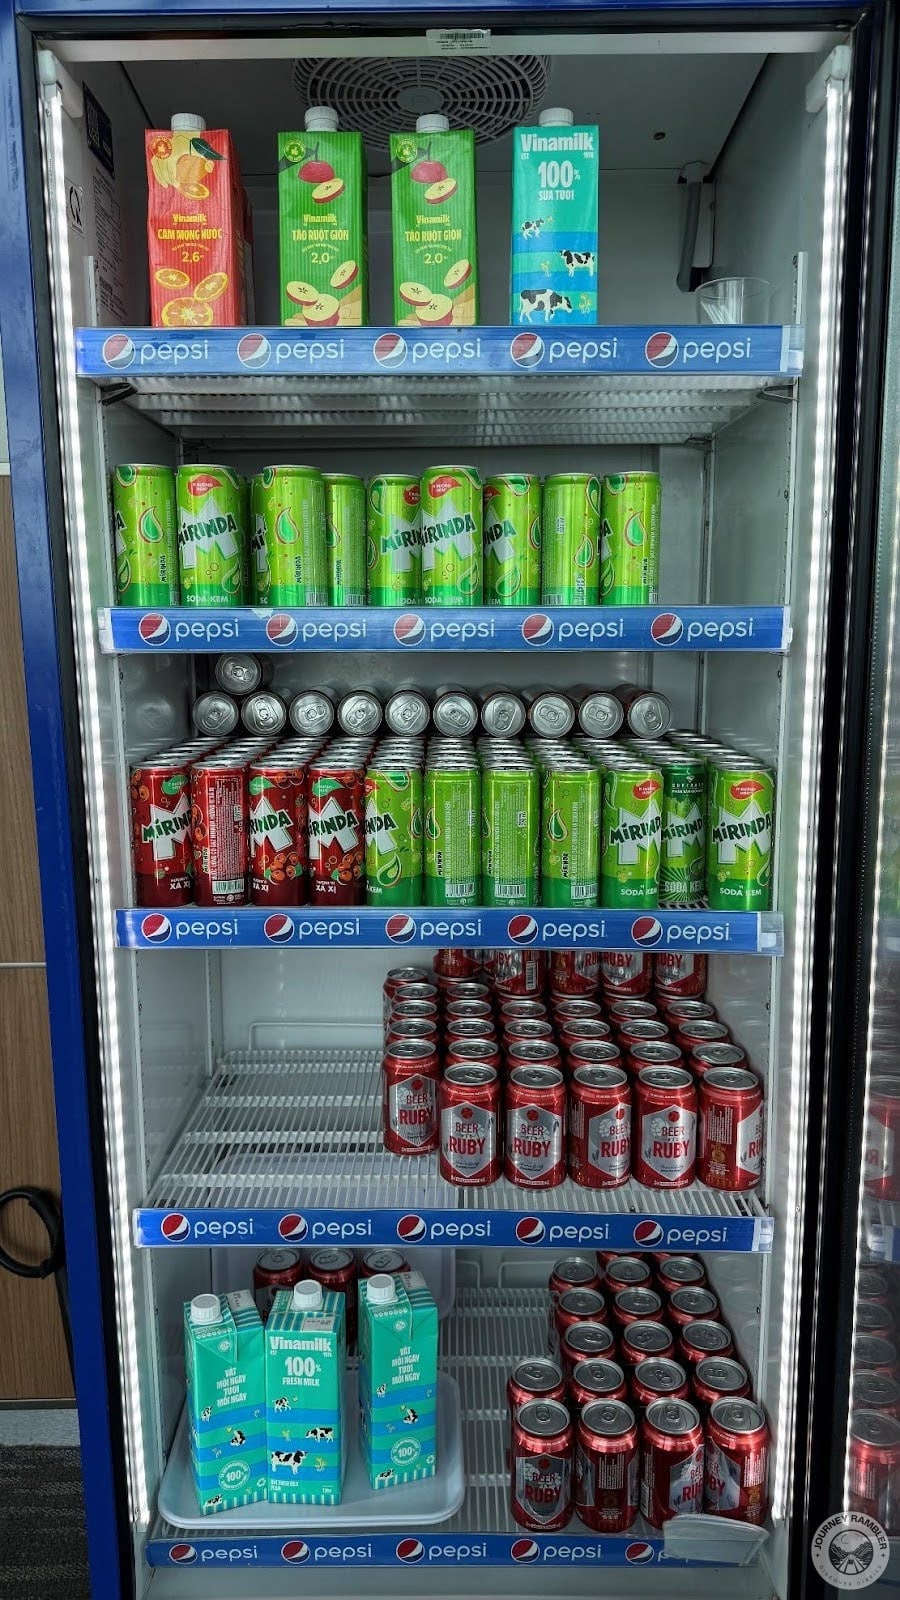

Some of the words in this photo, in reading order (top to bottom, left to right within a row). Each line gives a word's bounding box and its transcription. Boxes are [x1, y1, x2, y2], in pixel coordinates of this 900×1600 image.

[520, 132, 594, 152] Vinamilk
[537, 160, 581, 189] 100%
[303, 213, 338, 223] Vinamilk
[416, 213, 451, 224] Vinamilk
[140, 340, 208, 364] pepsi
[276, 339, 345, 363] pepsi
[412, 338, 481, 363] pepsi
[549, 338, 618, 363] pepsi
[683, 338, 751, 363] pepsi
[175, 618, 239, 642] pepsi
[302, 618, 367, 642] pepsi
[430, 618, 495, 642] pepsi
[558, 618, 624, 642] pepsi
[687, 617, 753, 642] pepsi
[620, 888, 644, 896] SODA
[664, 881, 687, 893] SODA
[719, 887, 744, 897] SODA
[176, 918, 238, 940] pepsi
[299, 918, 360, 940] pepsi
[420, 918, 482, 941] pepsi
[542, 919, 606, 942] pepsi
[667, 922, 730, 944] pepsi
[406, 1092, 428, 1105] BEER
[400, 1105, 433, 1126] RUBY
[455, 1122, 479, 1134] BEER
[521, 1123, 544, 1136] BEER
[661, 1125, 685, 1137] BEER
[449, 1138, 486, 1155] RUBY
[513, 1137, 551, 1158] RUBY
[652, 1140, 689, 1158] RUBY
[193, 1218, 253, 1239] pepsi
[312, 1218, 372, 1240] pepsi
[430, 1219, 491, 1240] pepsi
[549, 1222, 610, 1243] pepsi
[667, 1226, 728, 1245] pepsi
[269, 1336, 333, 1352] Vinamilk
[284, 1356, 322, 1377] 100%
[282, 1376, 303, 1386] FRESH
[303, 1377, 320, 1387] MILK
[525, 1484, 561, 1504] RUBY
[201, 1545, 258, 1562] pepsi
[314, 1543, 372, 1561] pepsi
[428, 1542, 487, 1561] pepsi
[543, 1544, 601, 1562] pepsi
